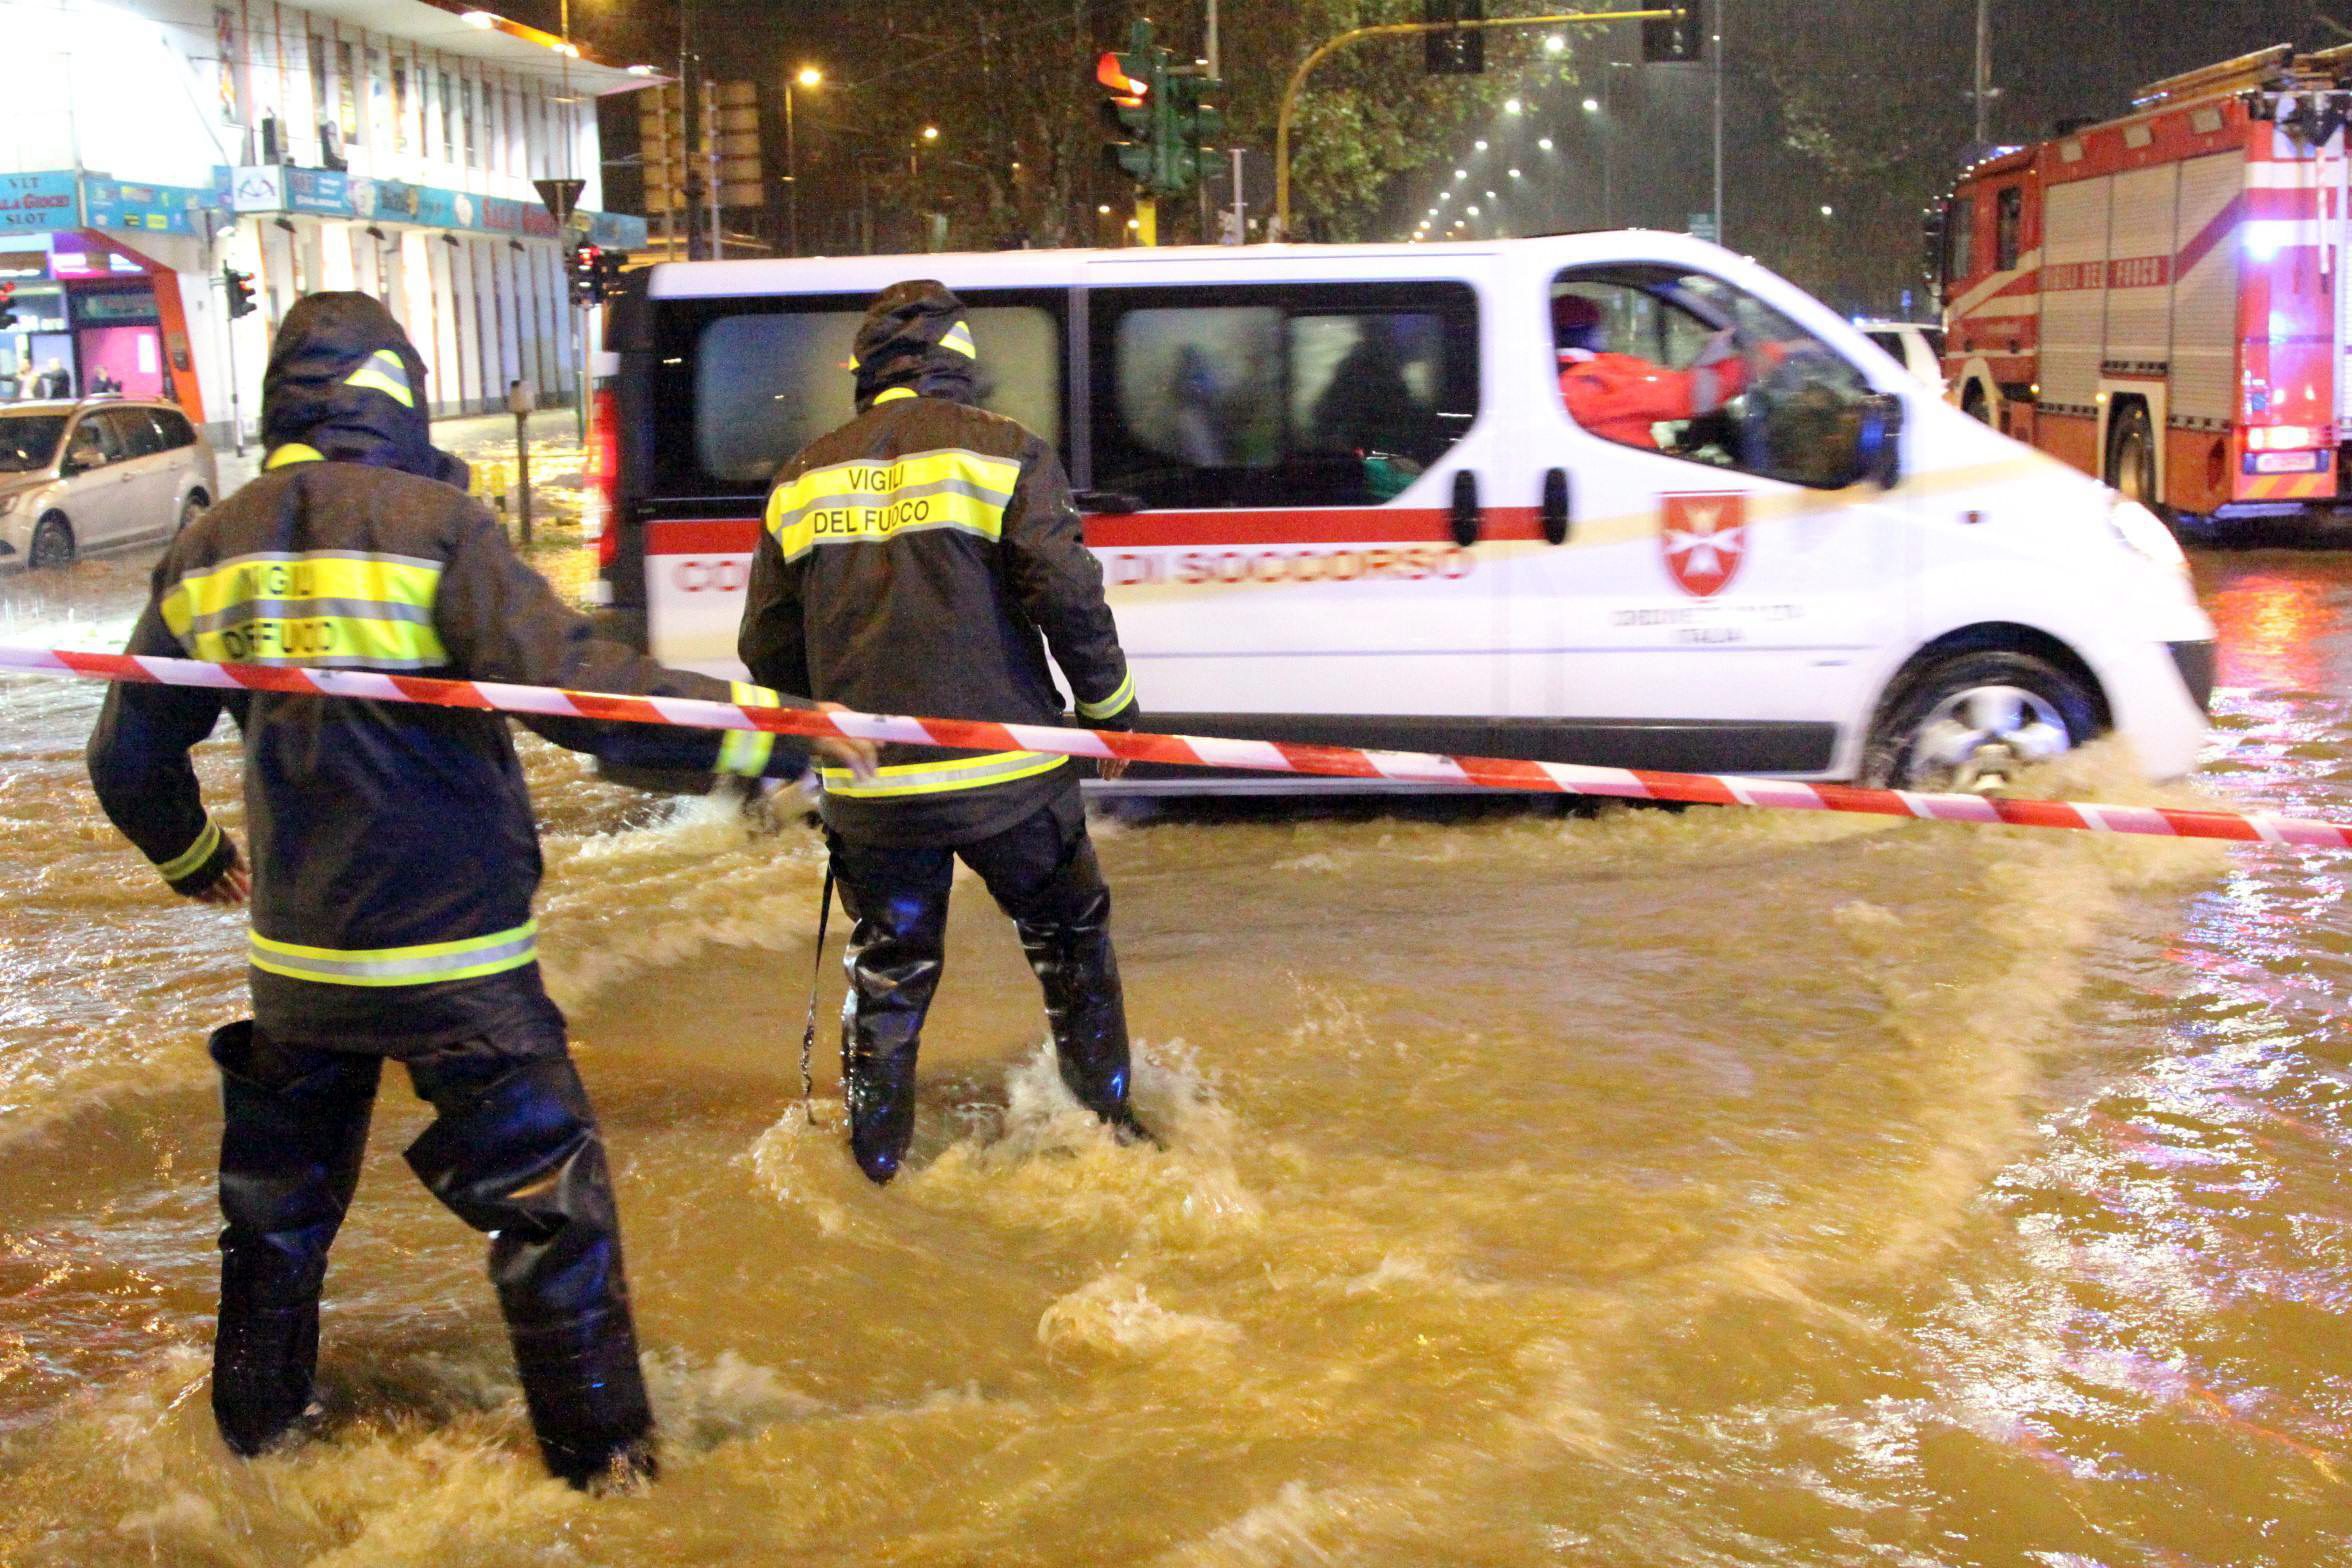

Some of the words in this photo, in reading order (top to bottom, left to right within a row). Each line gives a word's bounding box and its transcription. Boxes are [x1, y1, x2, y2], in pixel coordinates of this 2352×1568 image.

[848, 465, 904, 491] VIGILI
[813, 510, 857, 534] DEL
[864, 500, 929, 532] FUOCO
[1175, 547, 1474, 585] SOCCORSO
